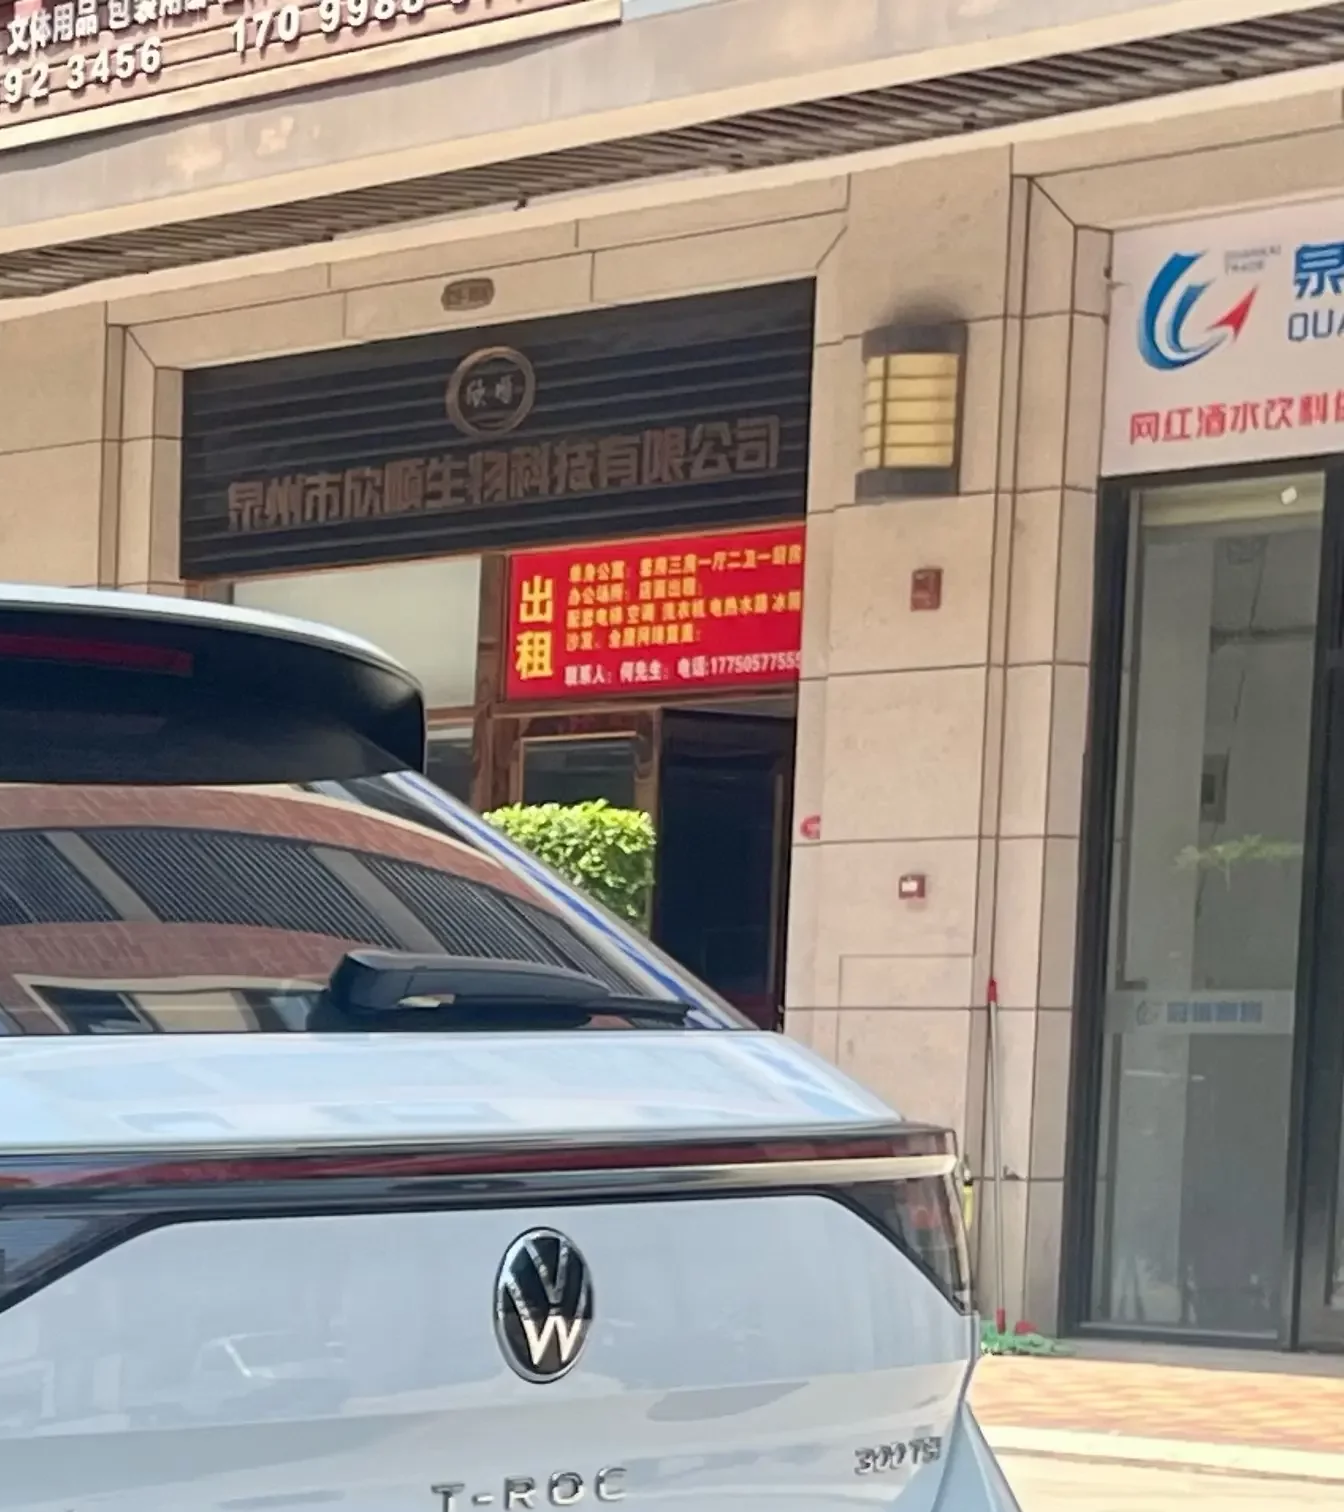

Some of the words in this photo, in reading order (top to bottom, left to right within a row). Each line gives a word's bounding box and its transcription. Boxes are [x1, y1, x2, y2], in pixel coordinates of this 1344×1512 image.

[67, 36, 162, 89] 3456
[233, 5, 300, 52] 170
[516, 574, 554, 681] 出租
